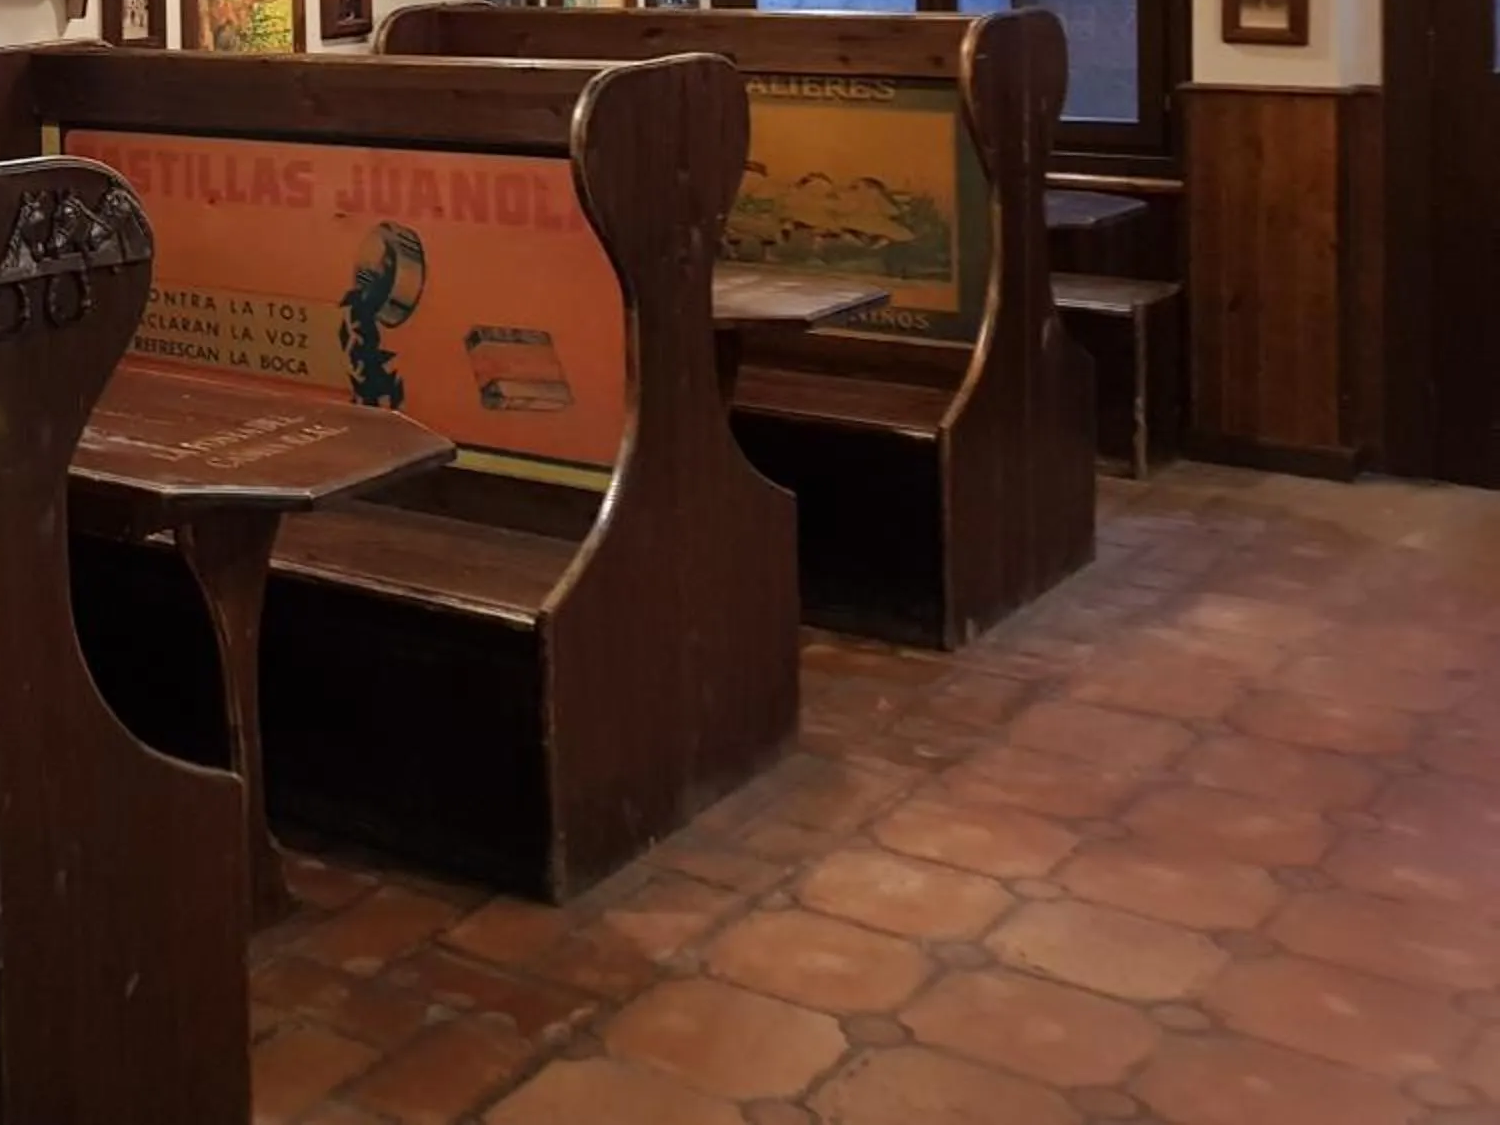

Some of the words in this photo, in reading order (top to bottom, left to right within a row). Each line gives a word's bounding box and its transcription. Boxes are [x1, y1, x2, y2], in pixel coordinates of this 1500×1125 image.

[72, 143, 314, 209] STILLAS
[149, 288, 217, 311] ONTRA
[230, 299, 254, 316] LA
[267, 302, 308, 324] TOS
[134, 335, 220, 362] REFRESCAN
[229, 350, 250, 367] LA
[260, 354, 309, 376] BOCA
[230, 325, 254, 342] LA
[265, 328, 309, 350] VOZ
